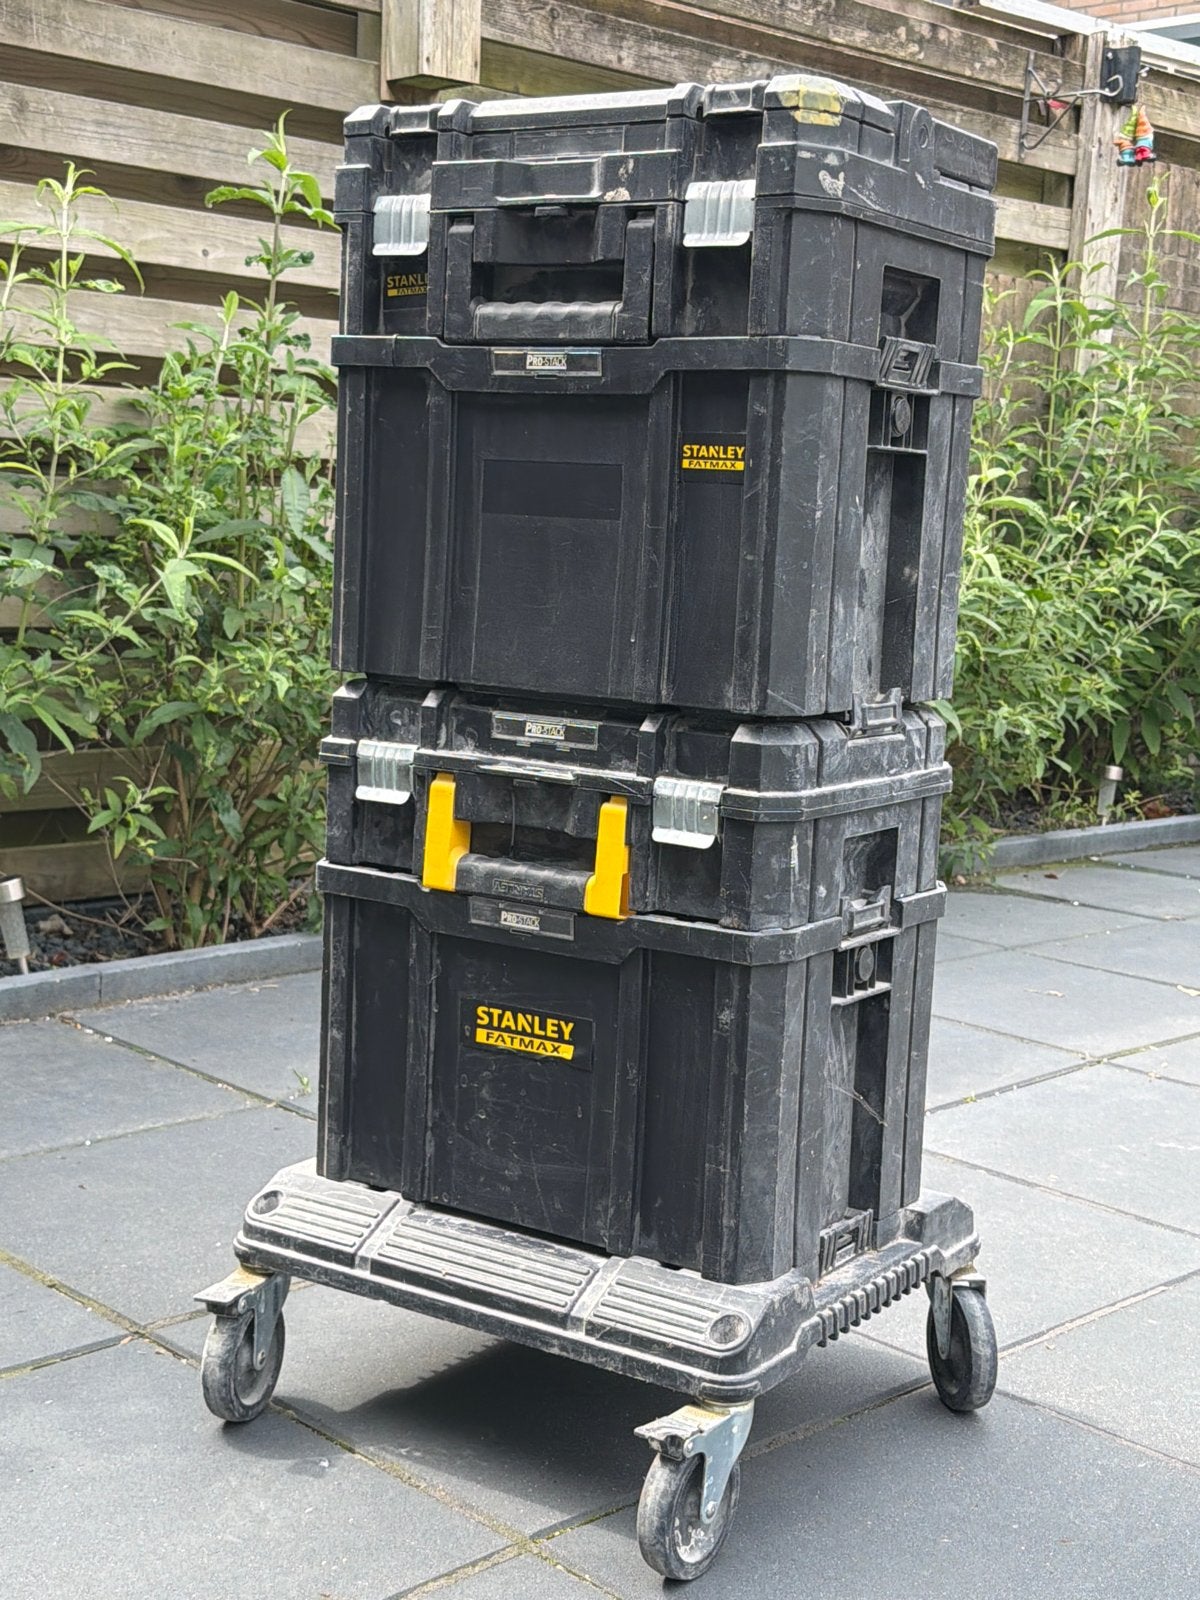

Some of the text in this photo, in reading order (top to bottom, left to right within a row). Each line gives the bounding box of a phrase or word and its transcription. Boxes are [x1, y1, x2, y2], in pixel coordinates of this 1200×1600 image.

[387, 273, 429, 288] STANL
[682, 444, 745, 459] STANLEY
[688, 460, 737, 469] FATMAX
[476, 1006, 574, 1041] STANLEY
[485, 1031, 562, 1055] FATMAX
